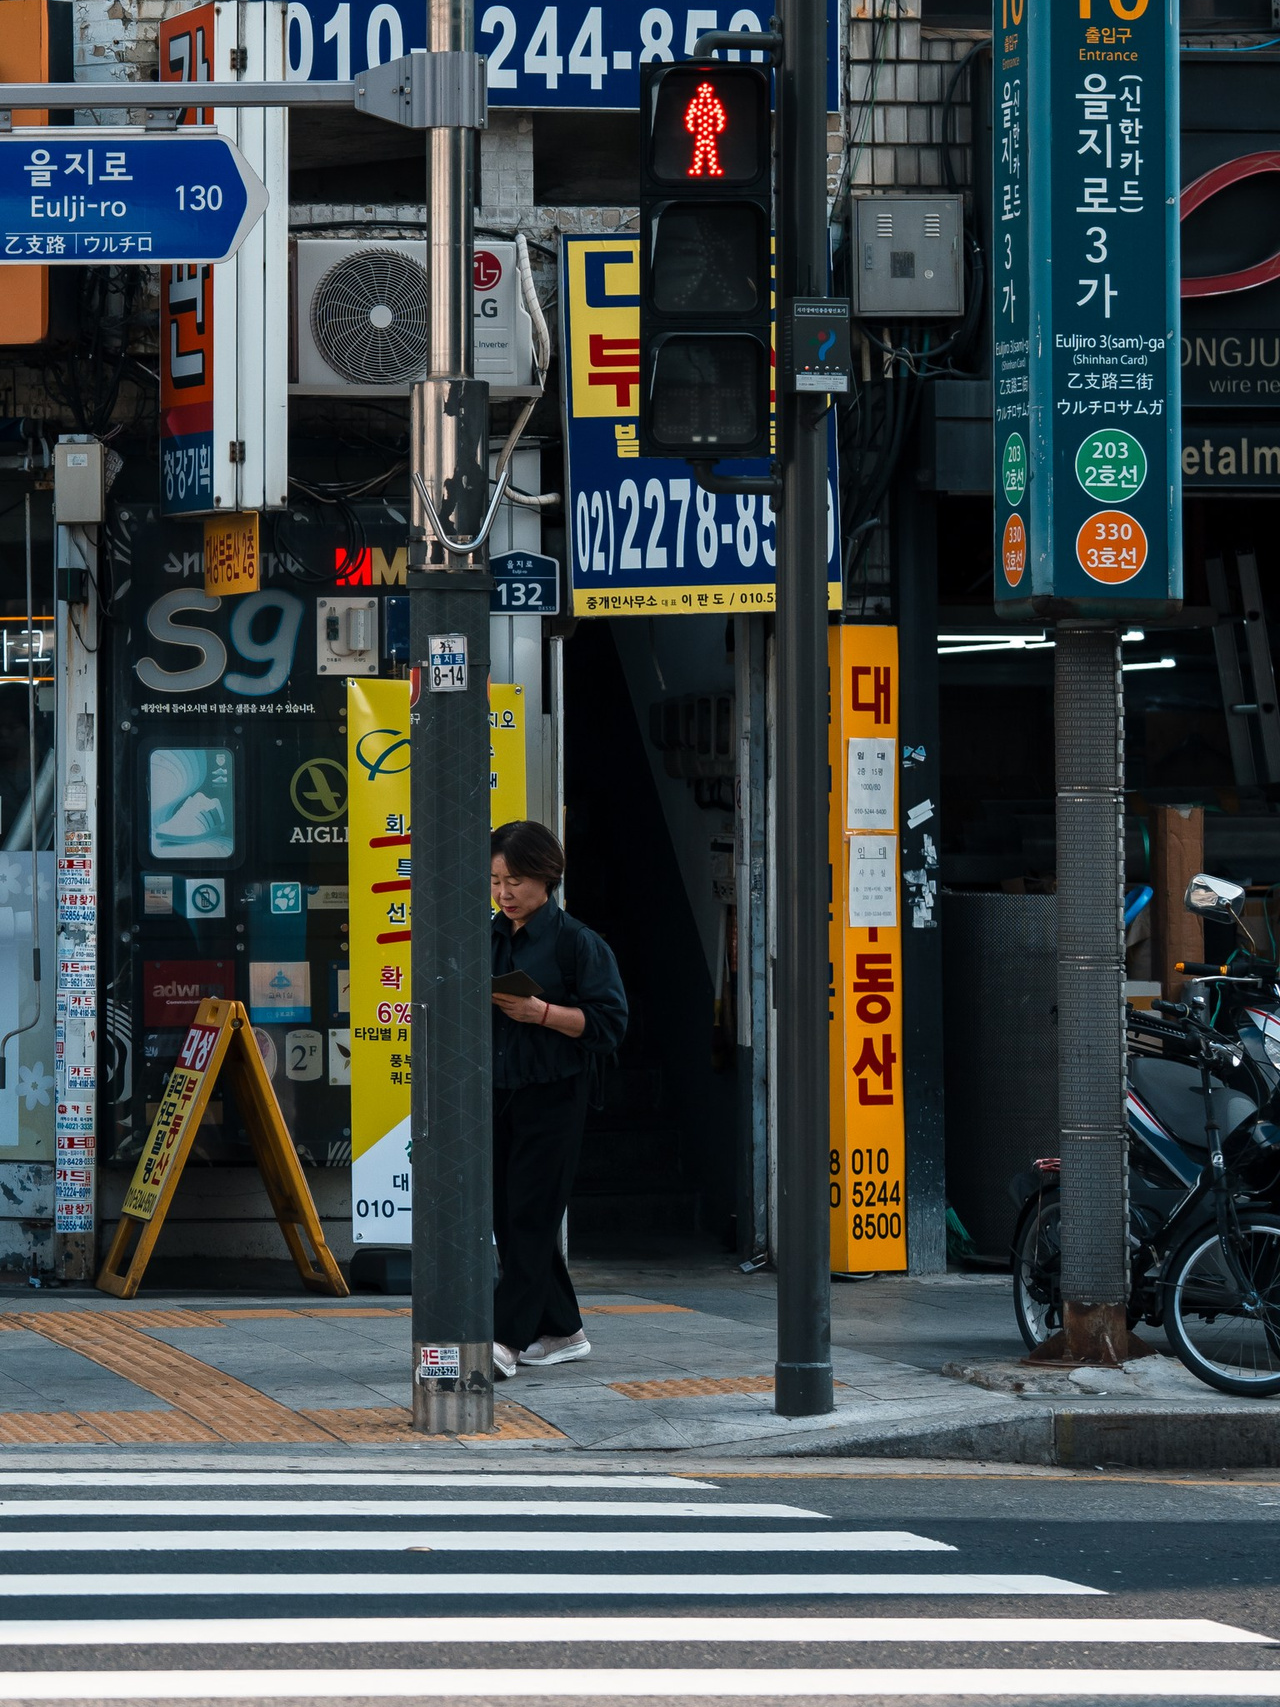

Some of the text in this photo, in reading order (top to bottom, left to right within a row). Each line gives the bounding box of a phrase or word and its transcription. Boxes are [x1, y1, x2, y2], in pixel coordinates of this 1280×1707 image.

[1085, 27, 1132, 44] 출입구
[1078, 49, 1138, 62] Entrance
[23, 149, 133, 187] 을지로
[31, 195, 127, 223] Eulji-ro
[175, 185, 223, 211] 130
[4, 236, 66, 255] 乙支路
[83, 236, 152, 254] ウルチロ
[479, 341, 508, 349] Inverter
[1055, 334, 1166, 351] Euljiro 3(sam)-ga
[1072, 354, 1148, 366] (Shinhan Card)
[1067, 372, 1154, 391] 乙支路三街
[1209, 376, 1252, 394] wire
[1056, 399, 1164, 416] ウルチロサムガ
[1008, 445, 1021, 462] 203
[1092, 442, 1129, 459] 203
[163, 444, 211, 501] 청강기획
[1005, 469, 1024, 491] 2호선
[1084, 465, 1138, 488] 2호선
[1008, 526, 1021, 544] 330
[1095, 523, 1132, 541] 330
[507, 560, 533, 569] 을지로
[1006, 551, 1023, 571] 3호선
[1086, 546, 1137, 569] 3호선
[497, 583, 542, 606] 132
[586, 594, 658, 610] 중개인사무소
[433, 654, 464, 665] 을지로
[434, 666, 464, 687] 8-14
[289, 827, 349, 844] AIGL
[60, 894, 96, 906] 사람찾기
[61, 962, 80, 973] 카드
[71, 996, 92, 1006] 카드
[354, 1027, 392, 1042] 타입별
[181, 1028, 216, 1071] 대성
[70, 1067, 92, 1076] 카드
[71, 1105, 92, 1114] 카드
[151, 1077, 199, 1186] 부동산
[58, 1137, 86, 1148] 카드
[851, 1147, 889, 1176] 010
[56, 1170, 85, 1182] 카드
[851, 1180, 902, 1208] 5244
[57, 1204, 93, 1215] 사람찾기
[851, 1211, 902, 1240] 8500
[422, 1349, 440, 1366] 카드
